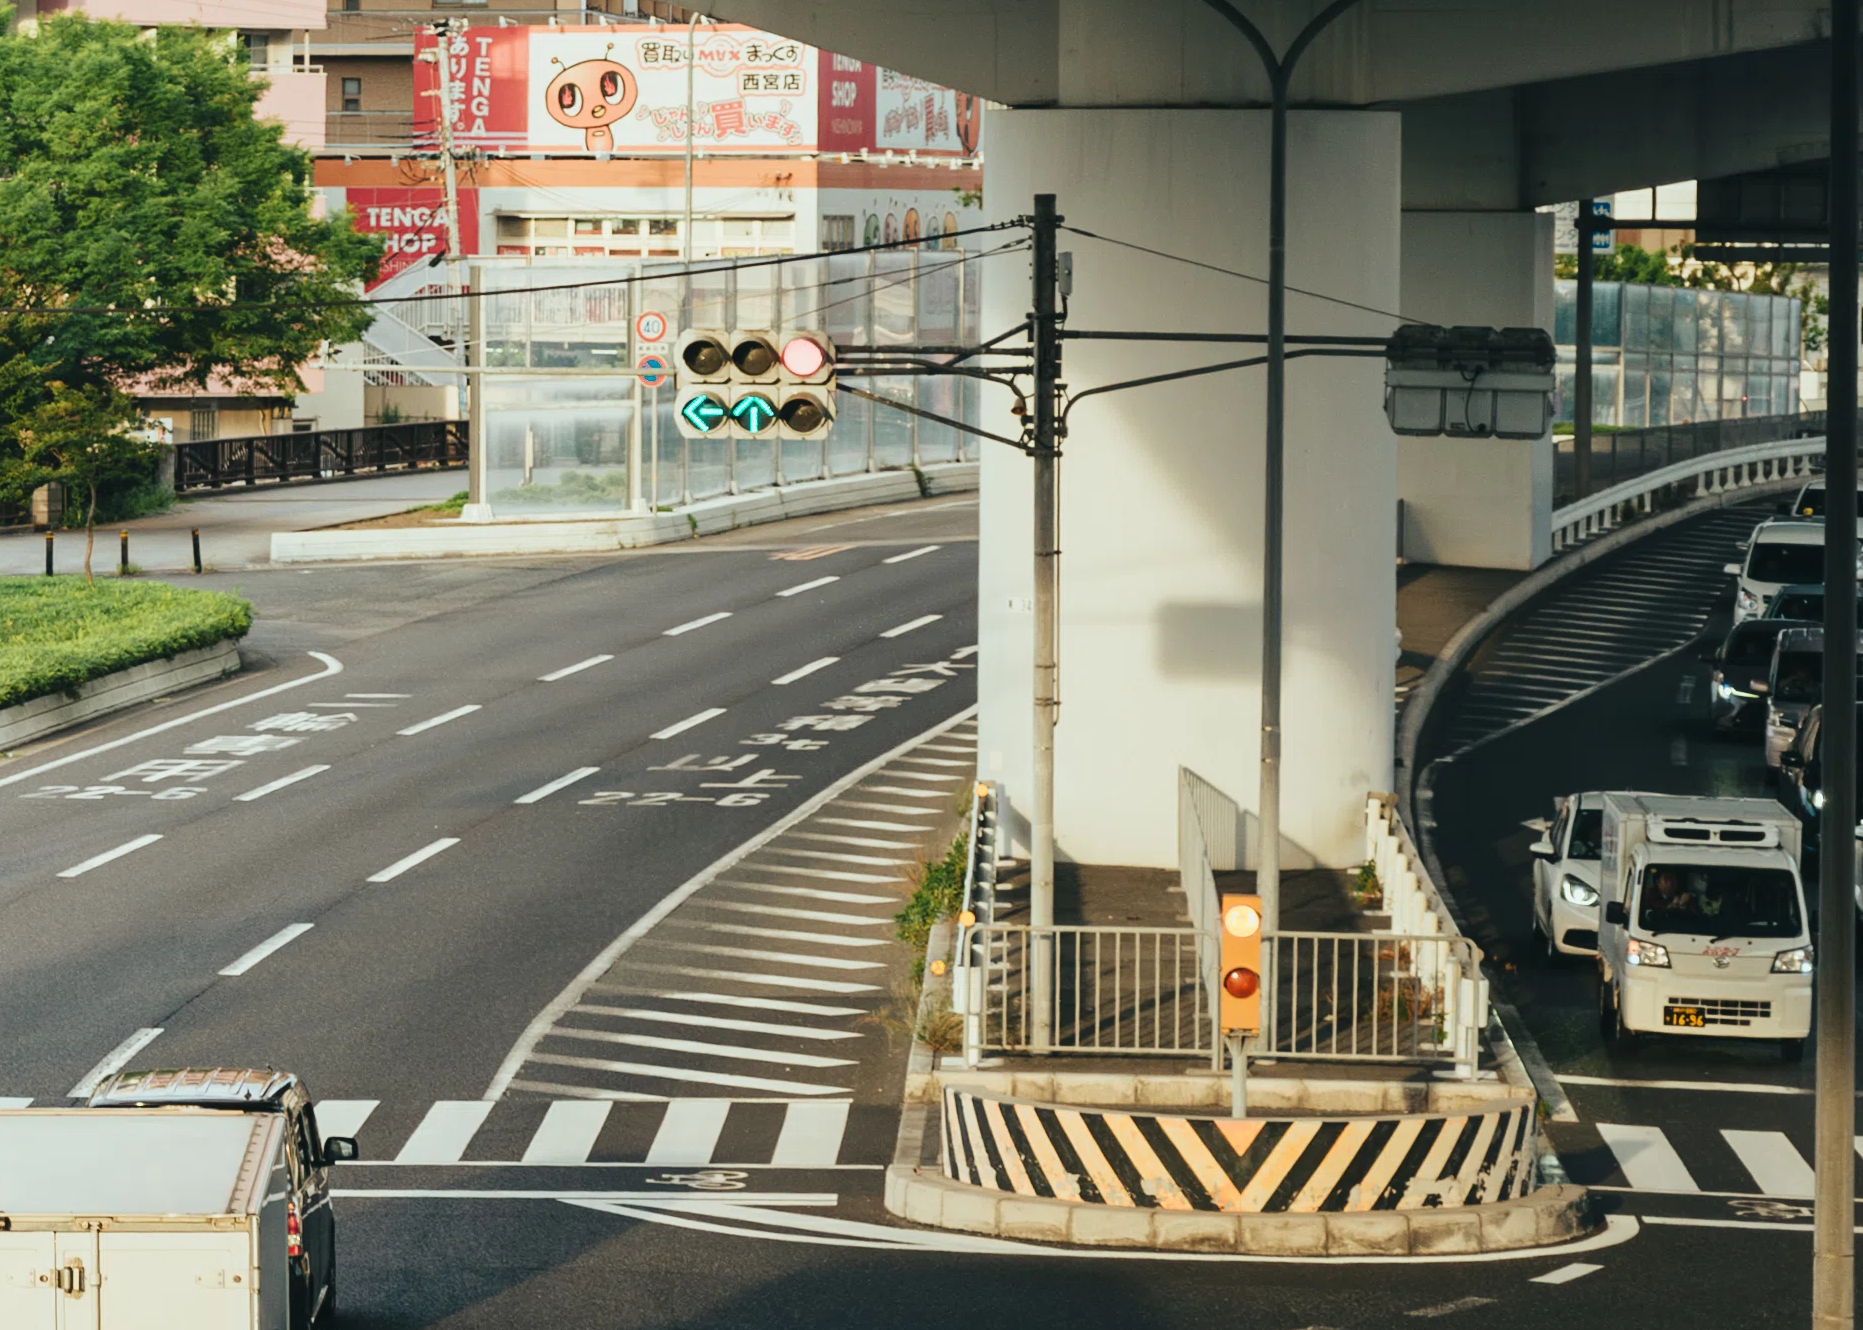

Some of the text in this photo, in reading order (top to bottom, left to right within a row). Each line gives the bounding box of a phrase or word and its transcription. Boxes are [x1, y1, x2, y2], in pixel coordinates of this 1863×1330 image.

[746, 44, 799, 63] まっくす
[471, 37, 492, 137] TENGA
[743, 74, 801, 90] 西宮店
[832, 81, 857, 107] SHOP
[367, 207, 450, 227] TENGA
[383, 233, 436, 253] HOP
[644, 320, 660, 334] 40
[19, 785, 208, 800] 22-6
[578, 791, 771, 807] 22-6
